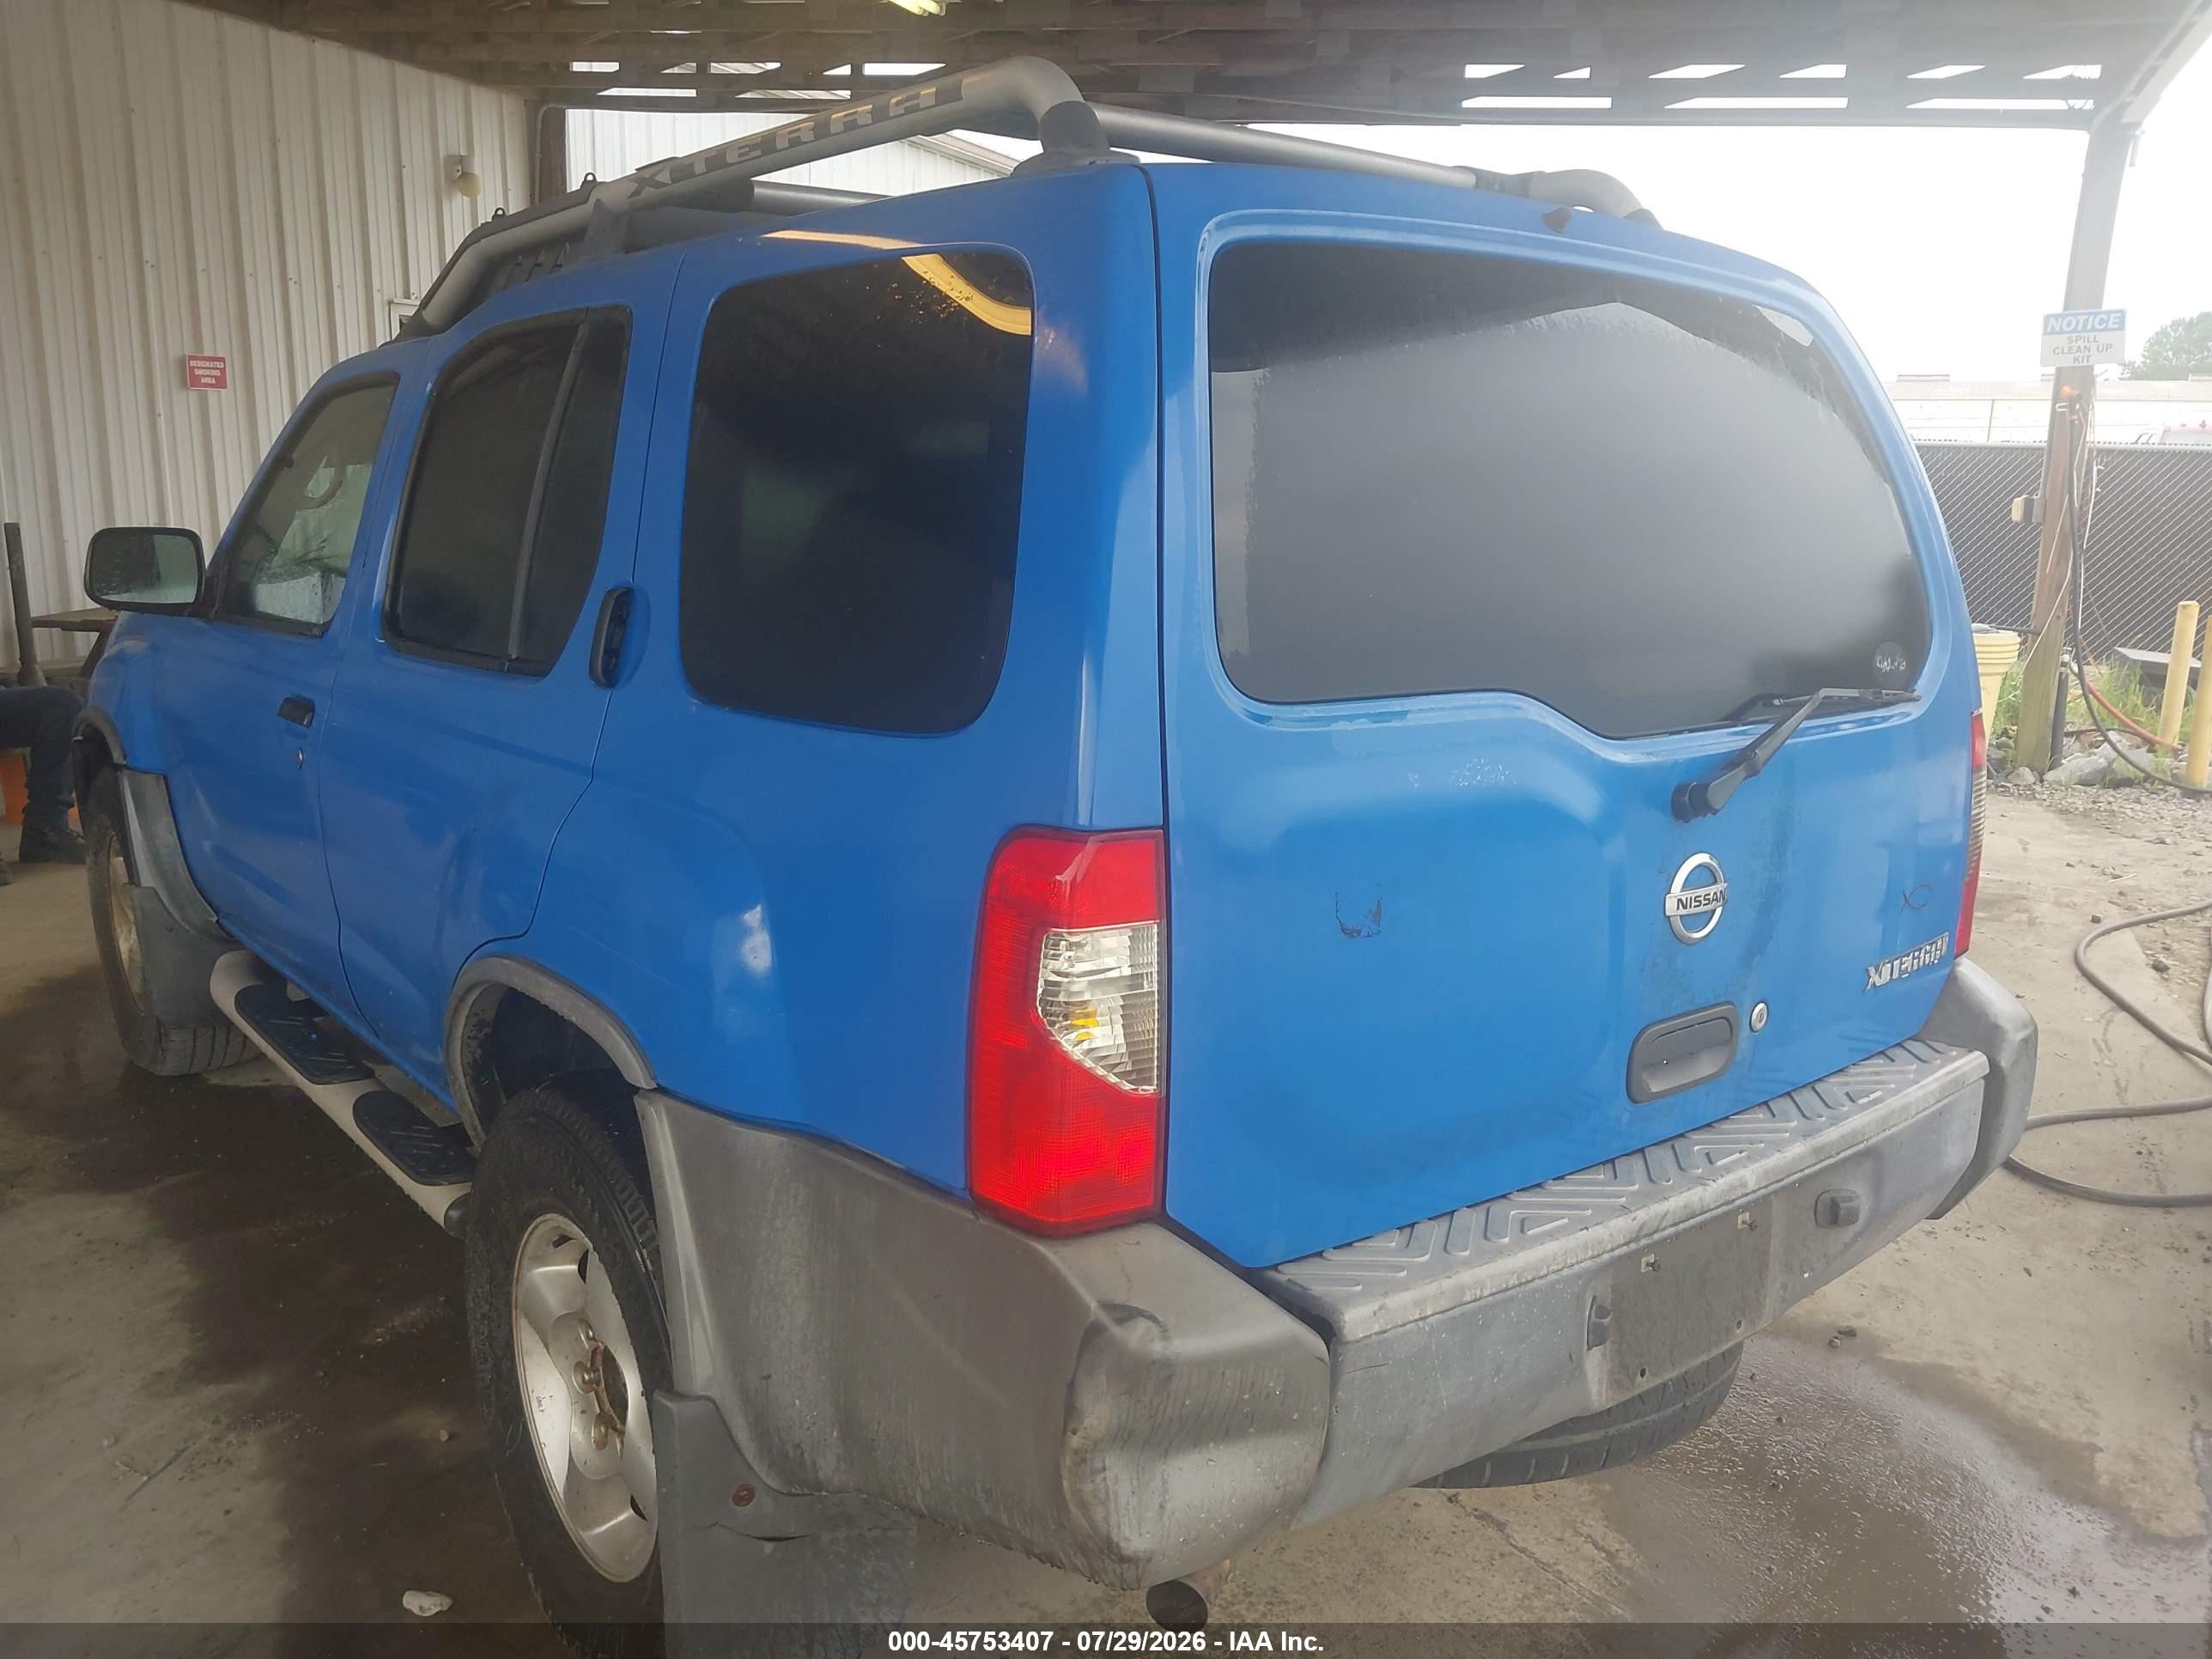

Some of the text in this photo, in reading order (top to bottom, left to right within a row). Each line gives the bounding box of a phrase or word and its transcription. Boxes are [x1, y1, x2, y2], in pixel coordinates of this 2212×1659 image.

[628, 87, 937, 199] XTERRA
[2047, 313, 2123, 332] NOTICE
[2067, 334, 2100, 344] SPILL
[2052, 343, 2113, 356] CLEAN UP
[190, 360, 224, 368] DESIGNATED
[2073, 355, 2092, 365] KIT
[1676, 888, 1726, 911] NISSAN
